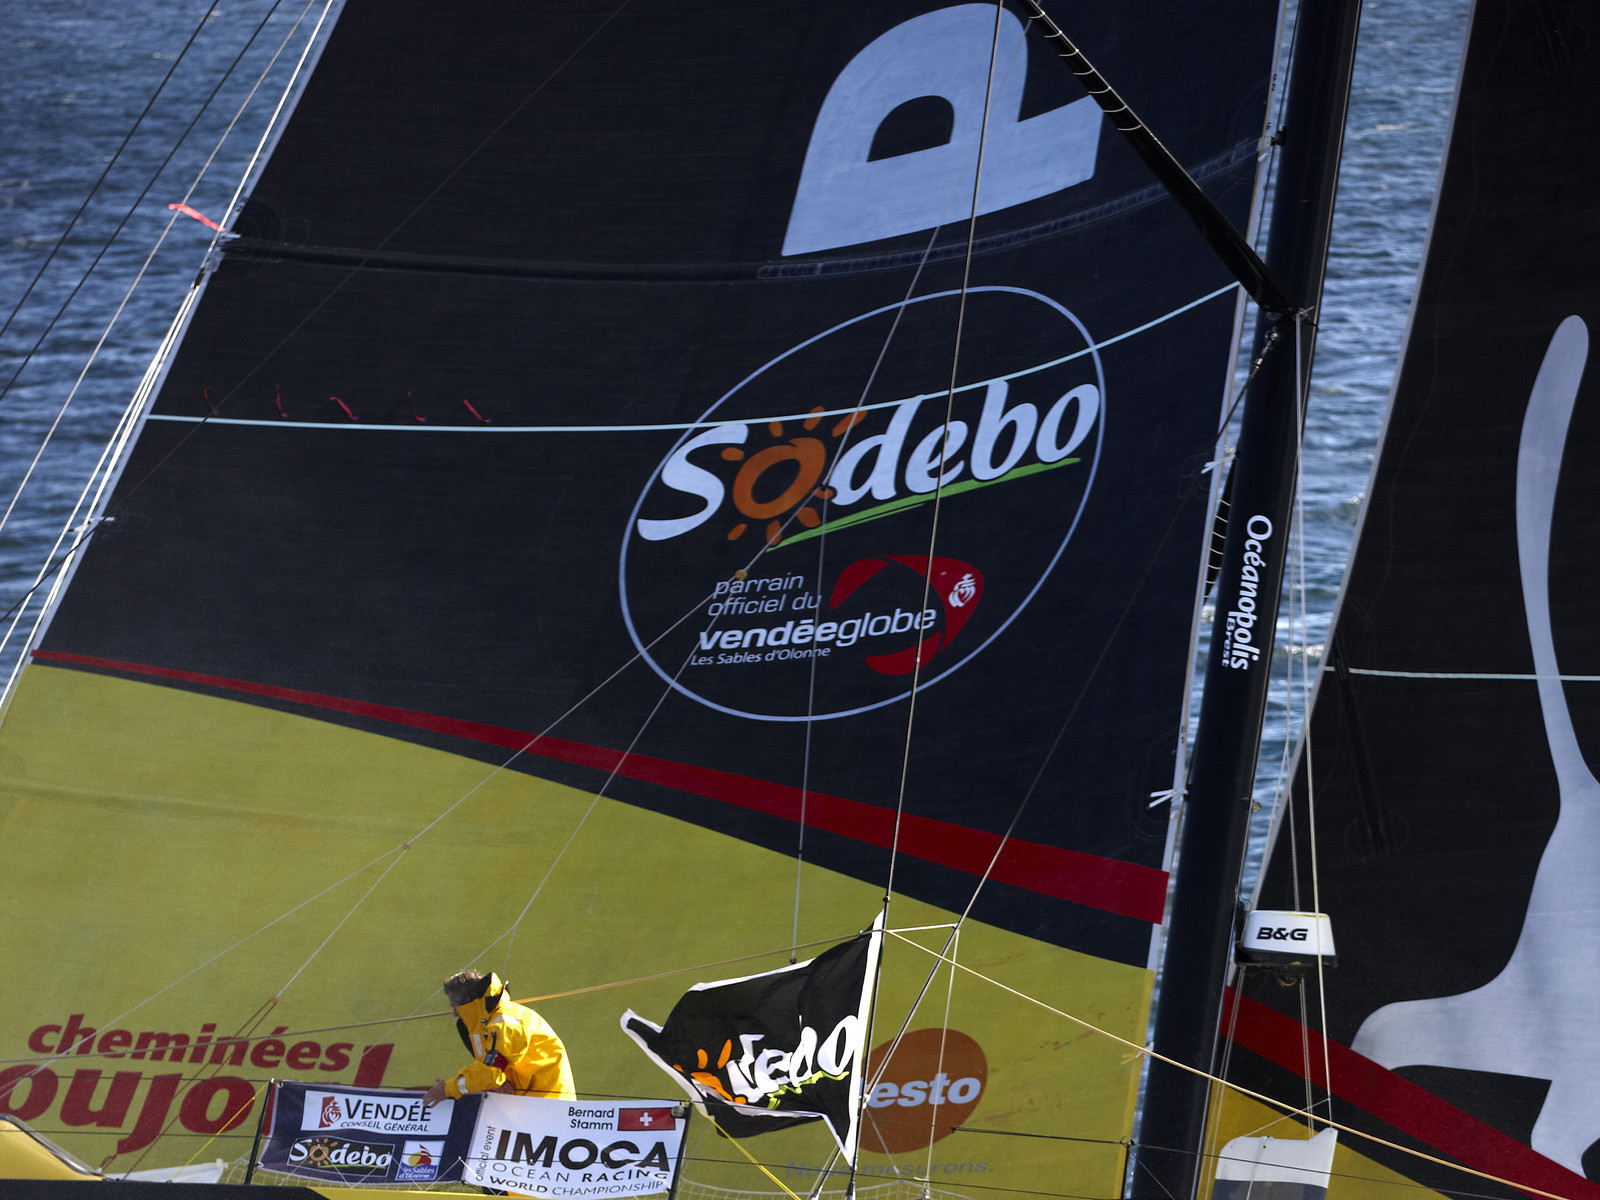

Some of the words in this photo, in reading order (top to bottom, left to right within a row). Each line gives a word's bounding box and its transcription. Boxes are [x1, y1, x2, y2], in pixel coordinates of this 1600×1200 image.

[637, 379, 1100, 541] Sodebo
[712, 572, 804, 599] parrain
[1228, 515, 1273, 670] Océanopolis
[708, 593, 787, 616] officiel
[791, 591, 822, 611] du
[1222, 617, 1236, 667] Brest
[690, 654, 715, 666] Les
[716, 651, 762, 665] Sables
[1256, 927, 1308, 941] B&G
[28, 1013, 354, 1072] cheminées
[859, 1073, 981, 1108] esto
[568, 1107, 615, 1118] Bernard
[570, 1119, 613, 1130] Stamm
[340, 1121, 381, 1130] CONSEIL
[384, 1122, 429, 1132] GÉNÉRAL
[289, 1138, 393, 1167] Sodebo
[475, 1151, 489, 1181] official
[484, 1126, 496, 1151] event
[495, 1130, 670, 1172] IMOCA
[489, 1176, 548, 1193] WORLD
[552, 1180, 664, 1196] CHAMPIONSHIP
[492, 1163, 570, 1182] OCEAN
[582, 1170, 668, 1182] RACING
